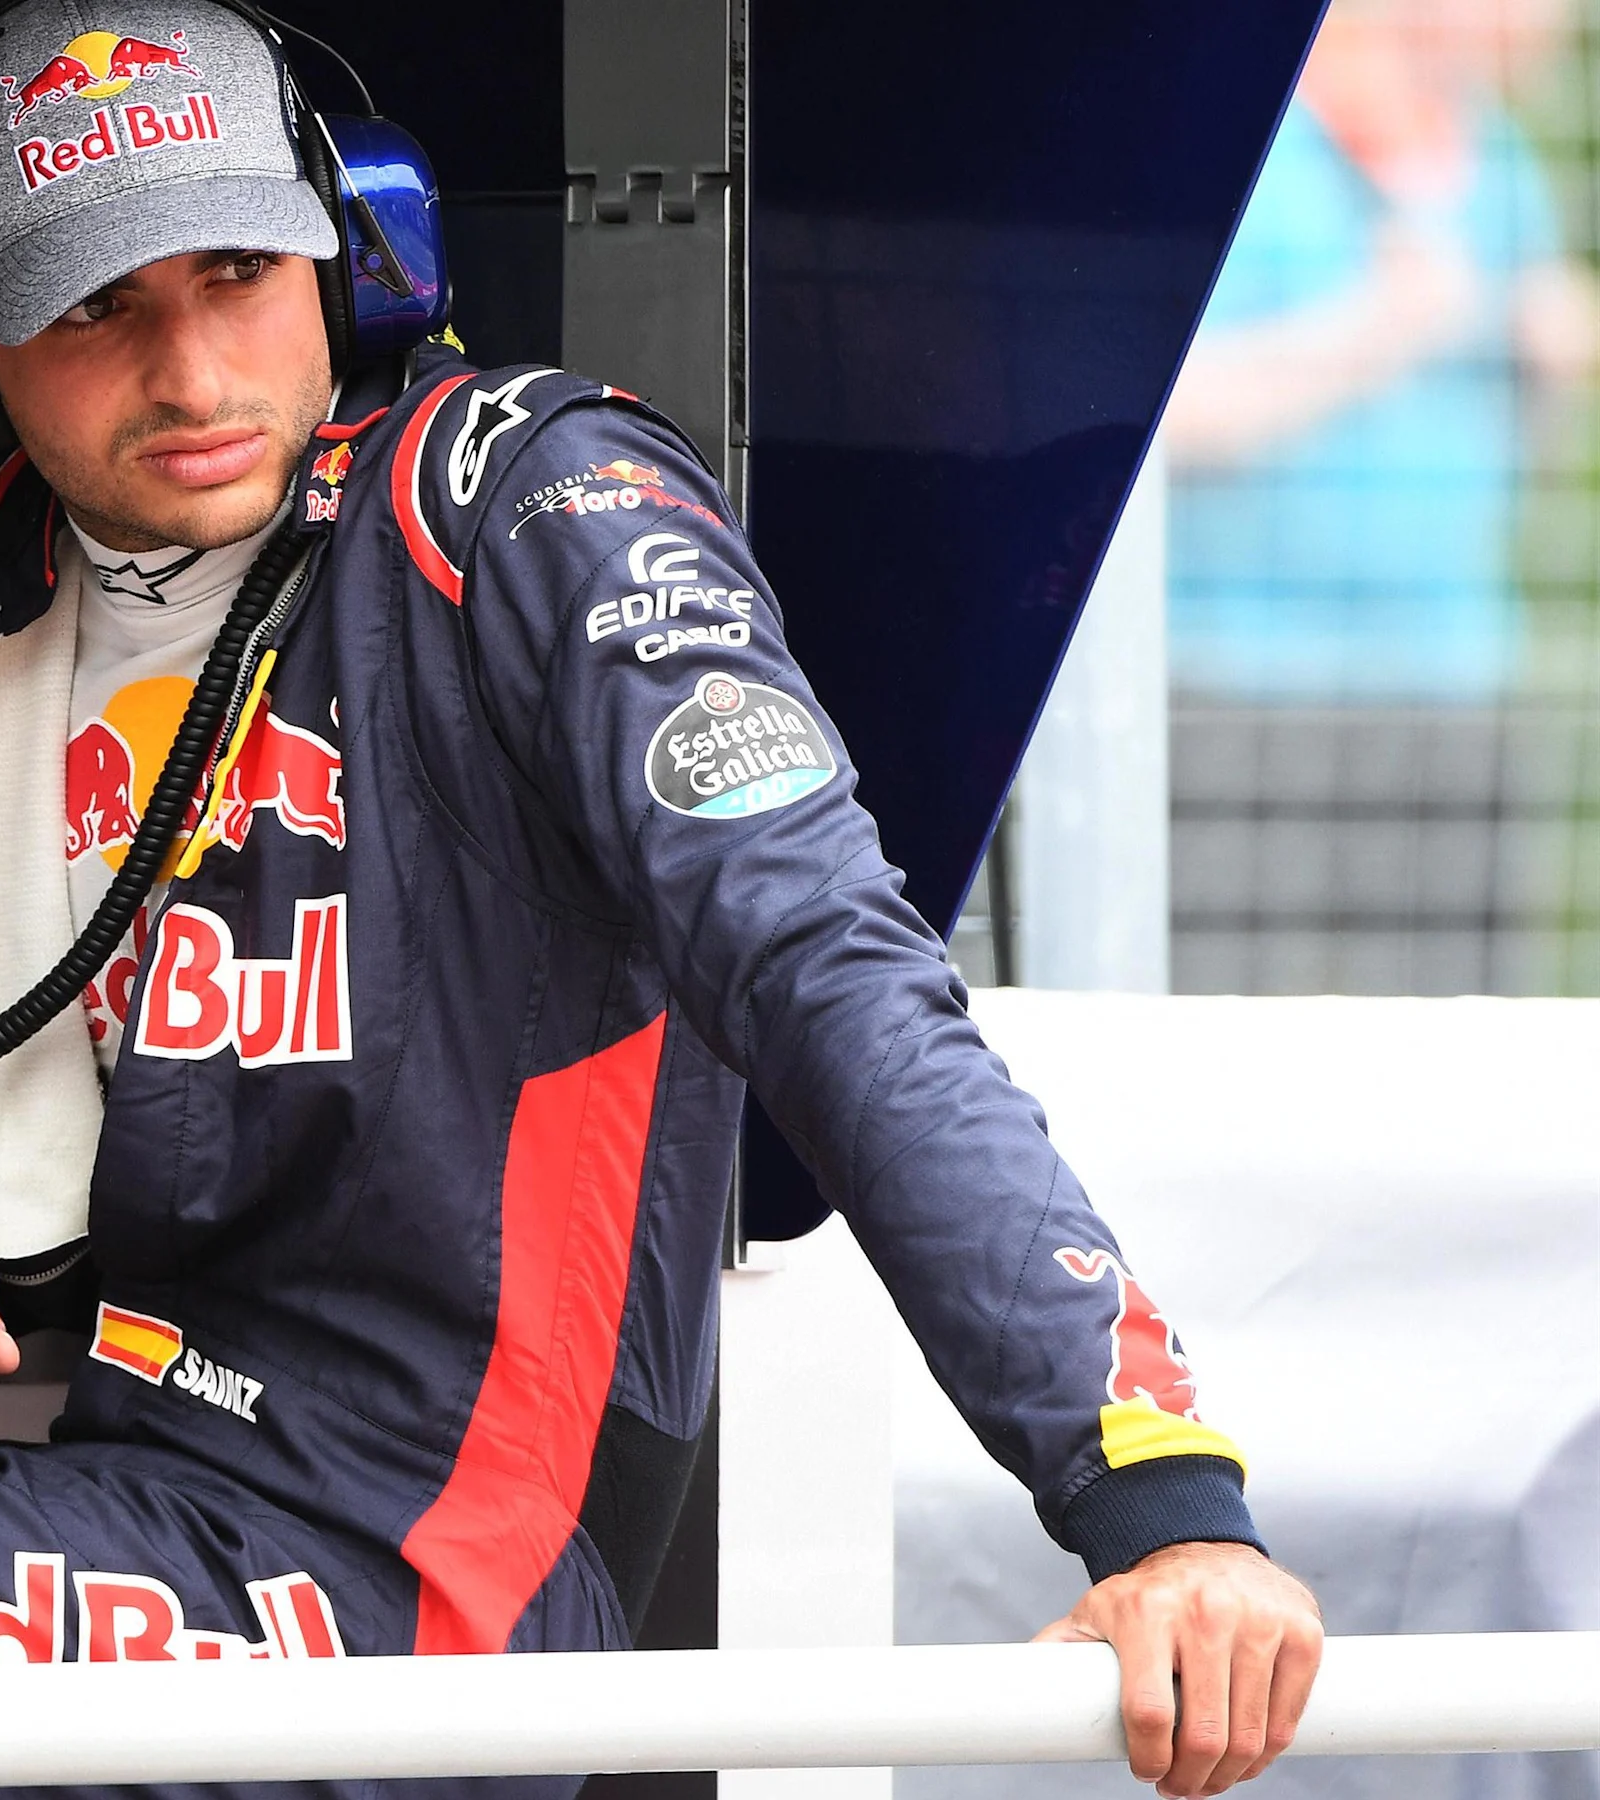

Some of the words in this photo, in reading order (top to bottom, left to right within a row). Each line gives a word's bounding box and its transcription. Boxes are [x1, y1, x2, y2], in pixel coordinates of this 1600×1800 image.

[16, 109, 116, 190] Red
[123, 95, 220, 152] Bull
[305, 487, 338, 521] Red
[515, 472, 594, 512] SCUDERIA
[542, 485, 642, 516] Toro
[585, 585, 755, 644] EDIFICE
[634, 621, 751, 663] CASIO
[667, 704, 808, 773] Estrella
[689, 735, 819, 797] Galicia
[138, 899, 346, 1064] Bull
[172, 1347, 265, 1424] SAINZ
[83, 1579, 336, 1663] Bll
